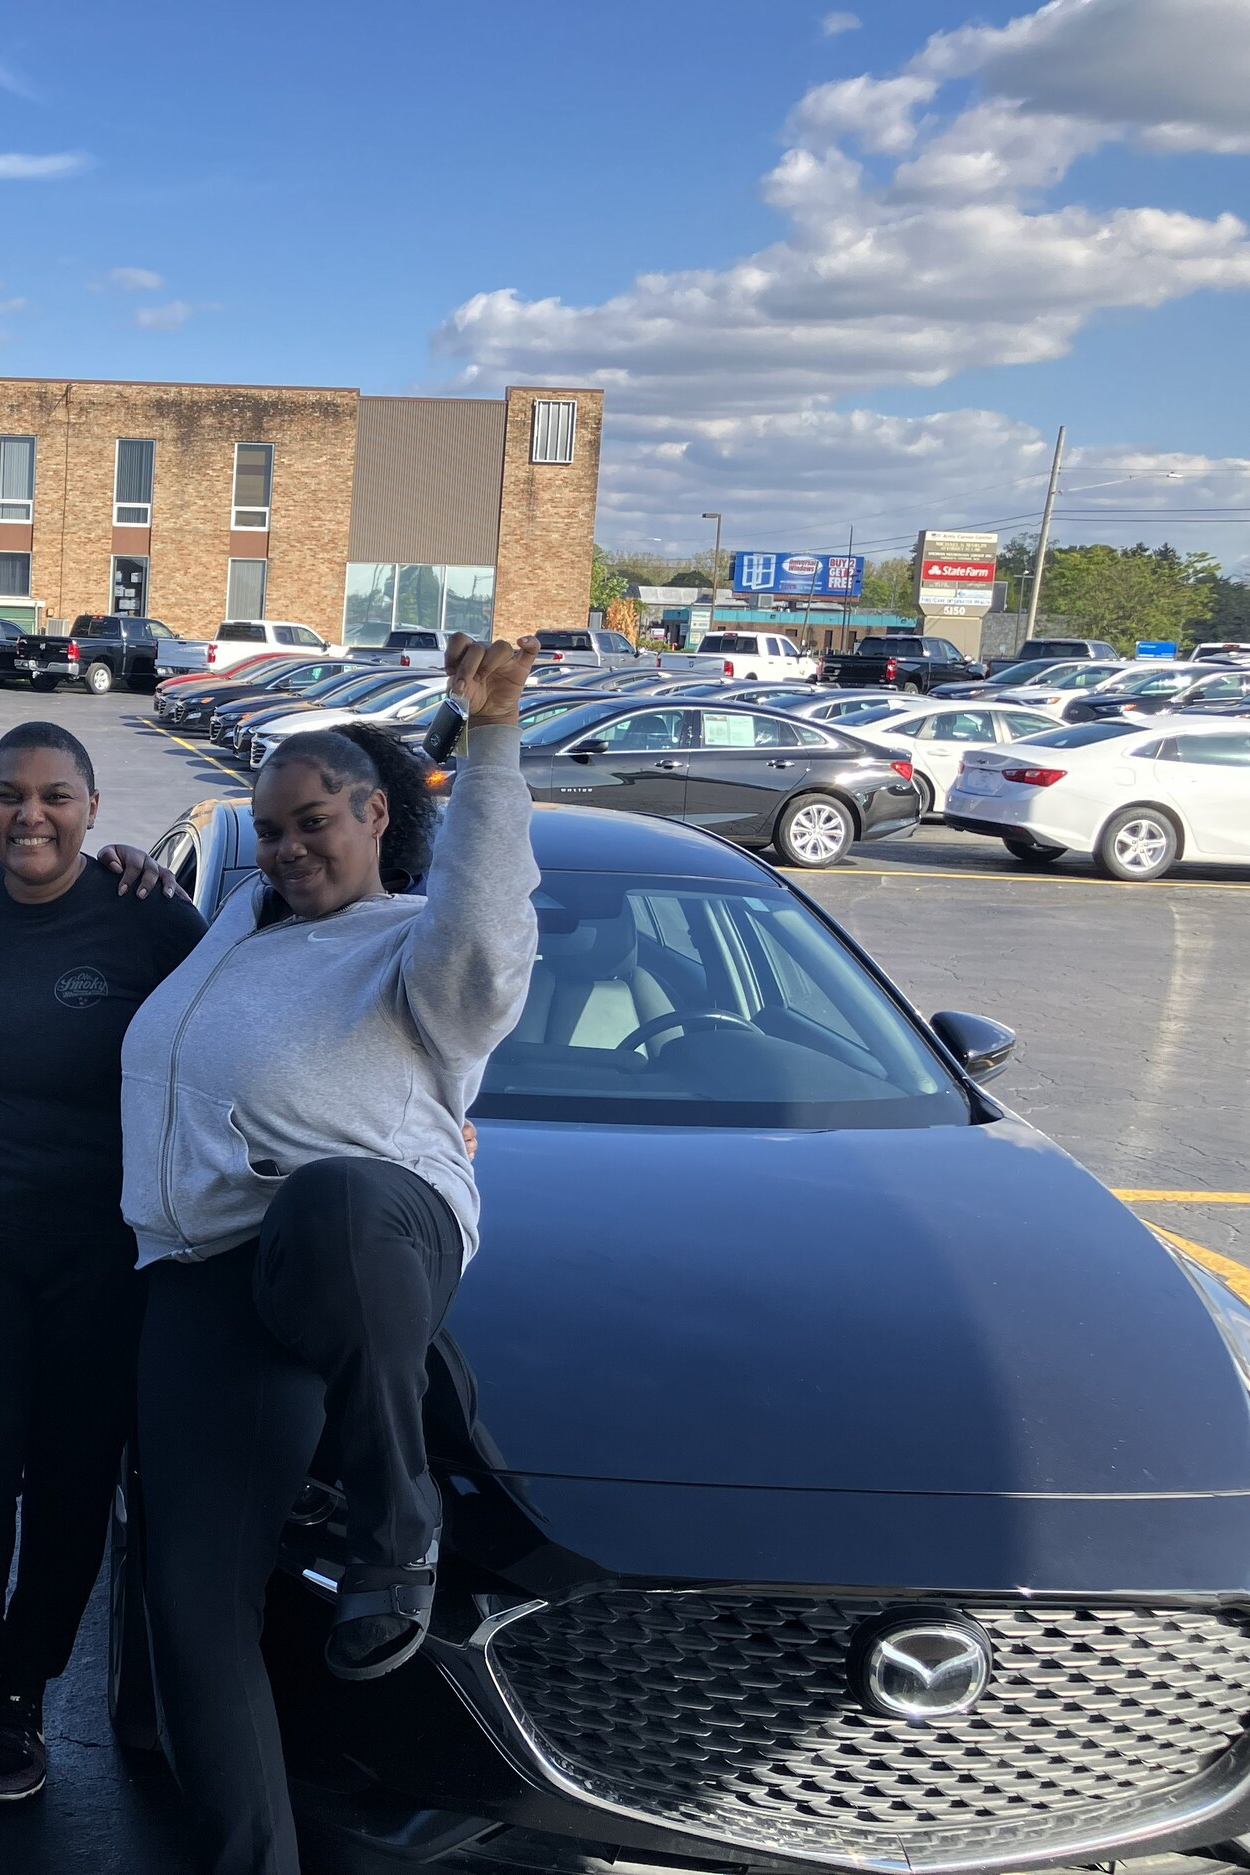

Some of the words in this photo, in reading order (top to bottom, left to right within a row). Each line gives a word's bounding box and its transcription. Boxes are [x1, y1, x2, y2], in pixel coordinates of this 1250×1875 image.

[789, 559, 817, 567] Universal
[830, 558, 847, 567] BUY
[829, 568, 846, 577] GET
[829, 577, 853, 589] FREE
[943, 605, 966, 615] 5150
[56, 976, 107, 992] Smoky
